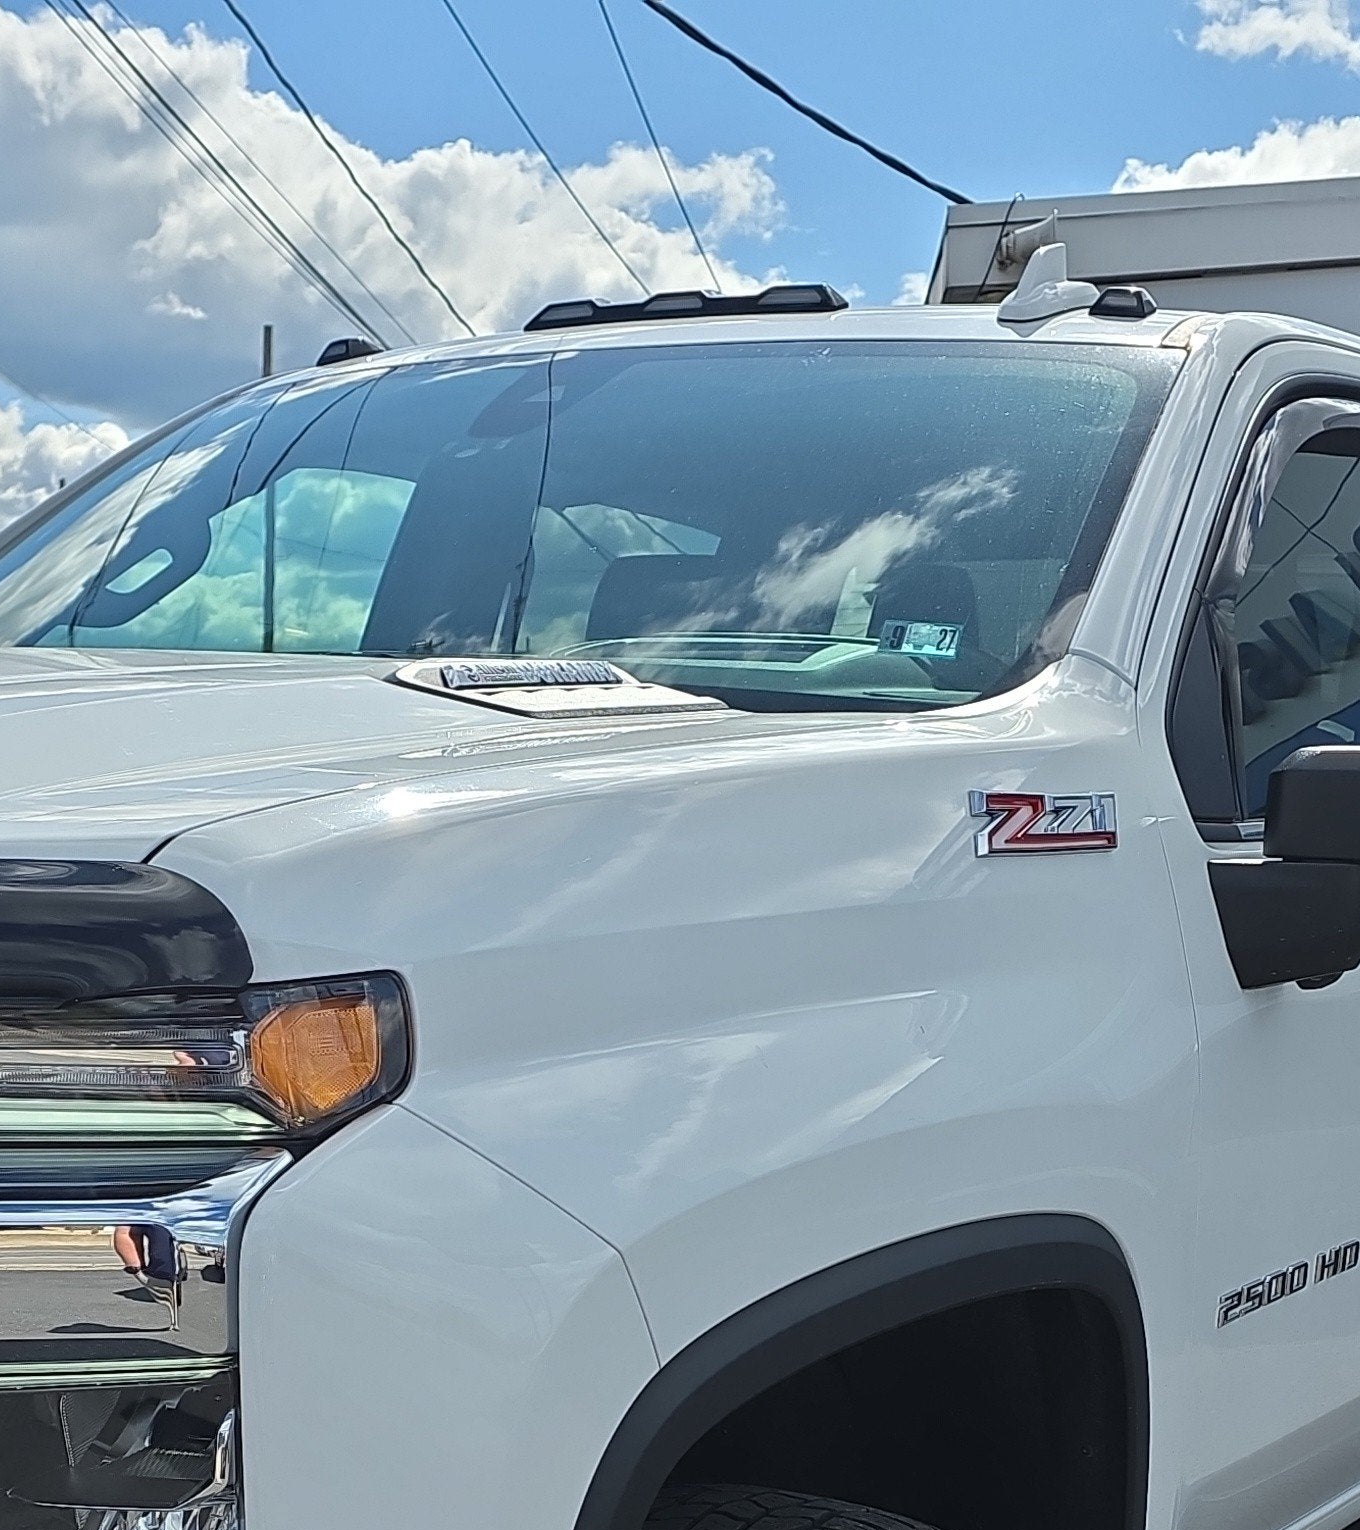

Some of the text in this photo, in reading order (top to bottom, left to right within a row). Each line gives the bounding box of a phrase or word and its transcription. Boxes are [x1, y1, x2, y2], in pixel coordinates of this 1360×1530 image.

[936, 628, 957, 652] 27
[968, 790, 1120, 858] Z71
[1216, 1239, 1360, 1329] 2500 HD
